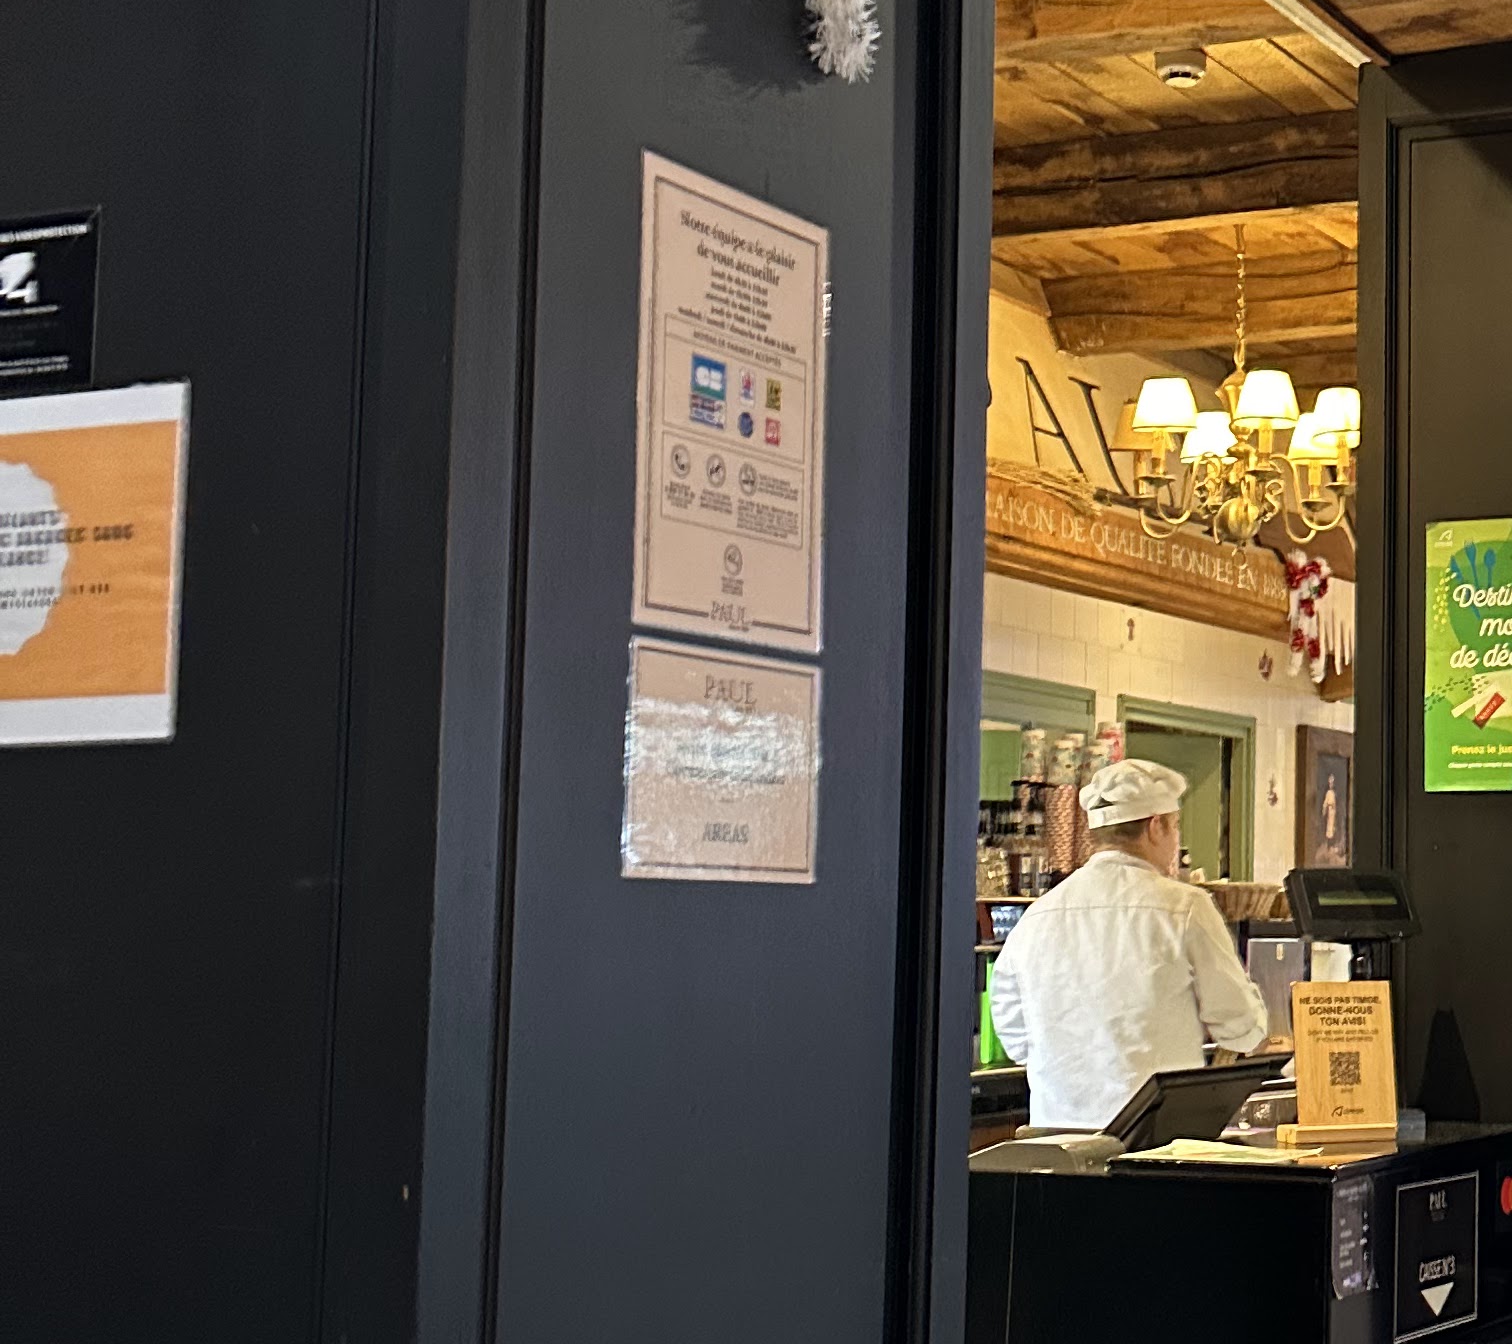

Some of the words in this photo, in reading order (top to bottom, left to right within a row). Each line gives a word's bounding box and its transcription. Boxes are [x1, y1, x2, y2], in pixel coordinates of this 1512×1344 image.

[1060, 517, 1088, 544] DE
[1236, 568, 1258, 592] EN
[1450, 645, 1479, 668] de
[704, 674, 758, 705] PAUL
[1452, 745, 1485, 755] Prenez
[1487, 744, 1496, 754] le
[702, 822, 751, 844] AREAS
[1308, 1006, 1373, 1016] DONNE-NOUS
[1320, 1016, 1339, 1026] TON
